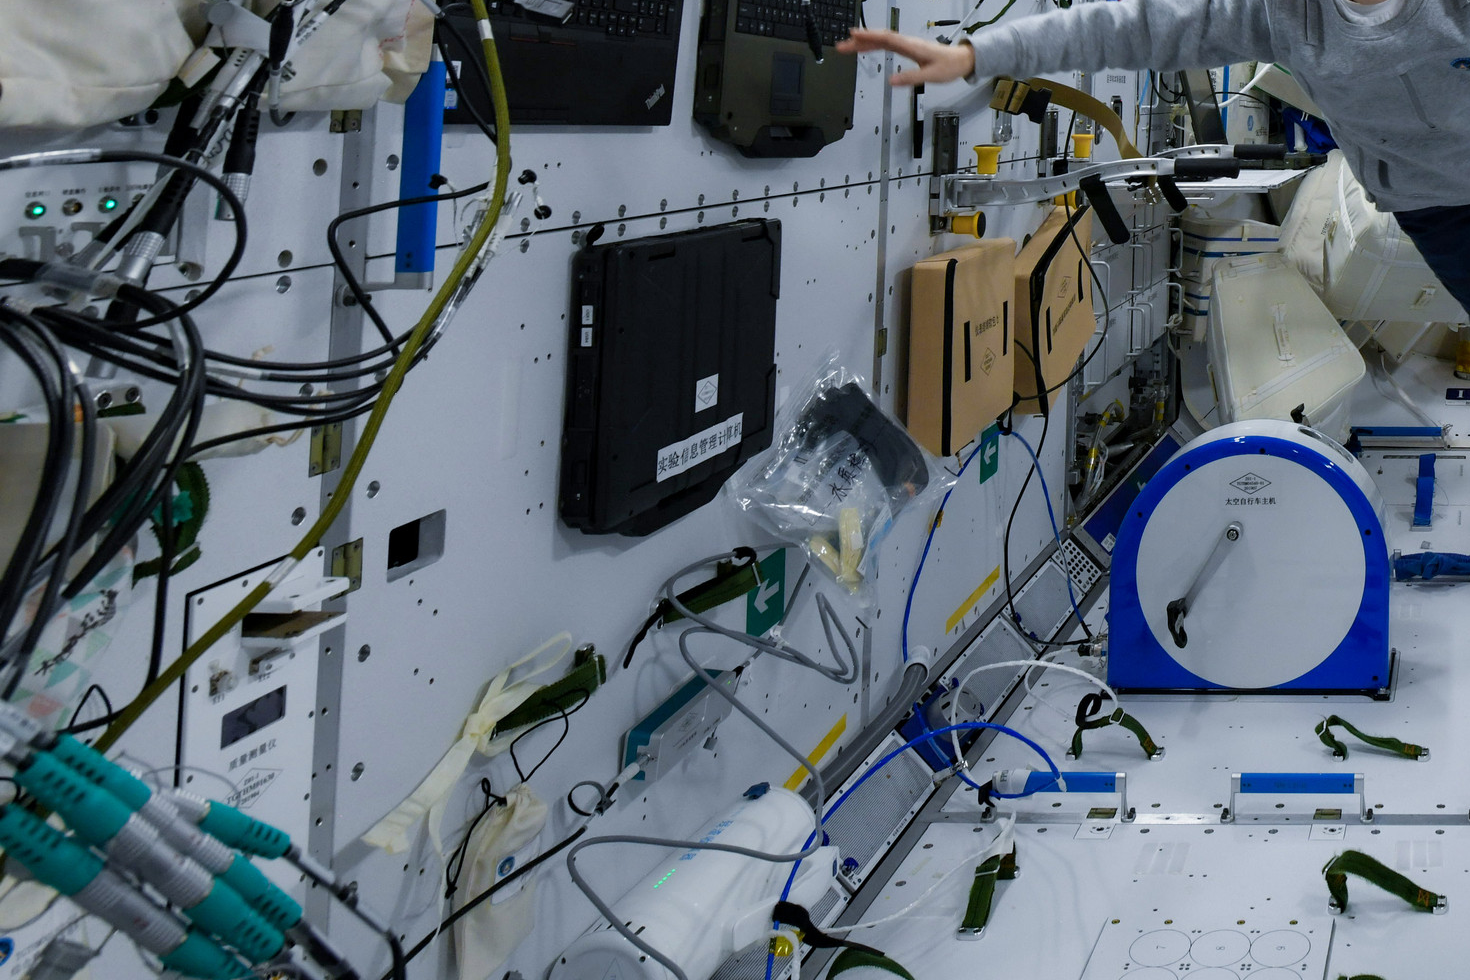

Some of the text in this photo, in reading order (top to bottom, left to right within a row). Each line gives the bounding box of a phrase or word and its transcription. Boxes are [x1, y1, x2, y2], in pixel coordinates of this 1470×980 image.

[645, 83, 666, 111] ThinkPad
[1225, 497, 1276, 506] 太空自行车主机
[228, 739, 277, 773] 质量测量仪
